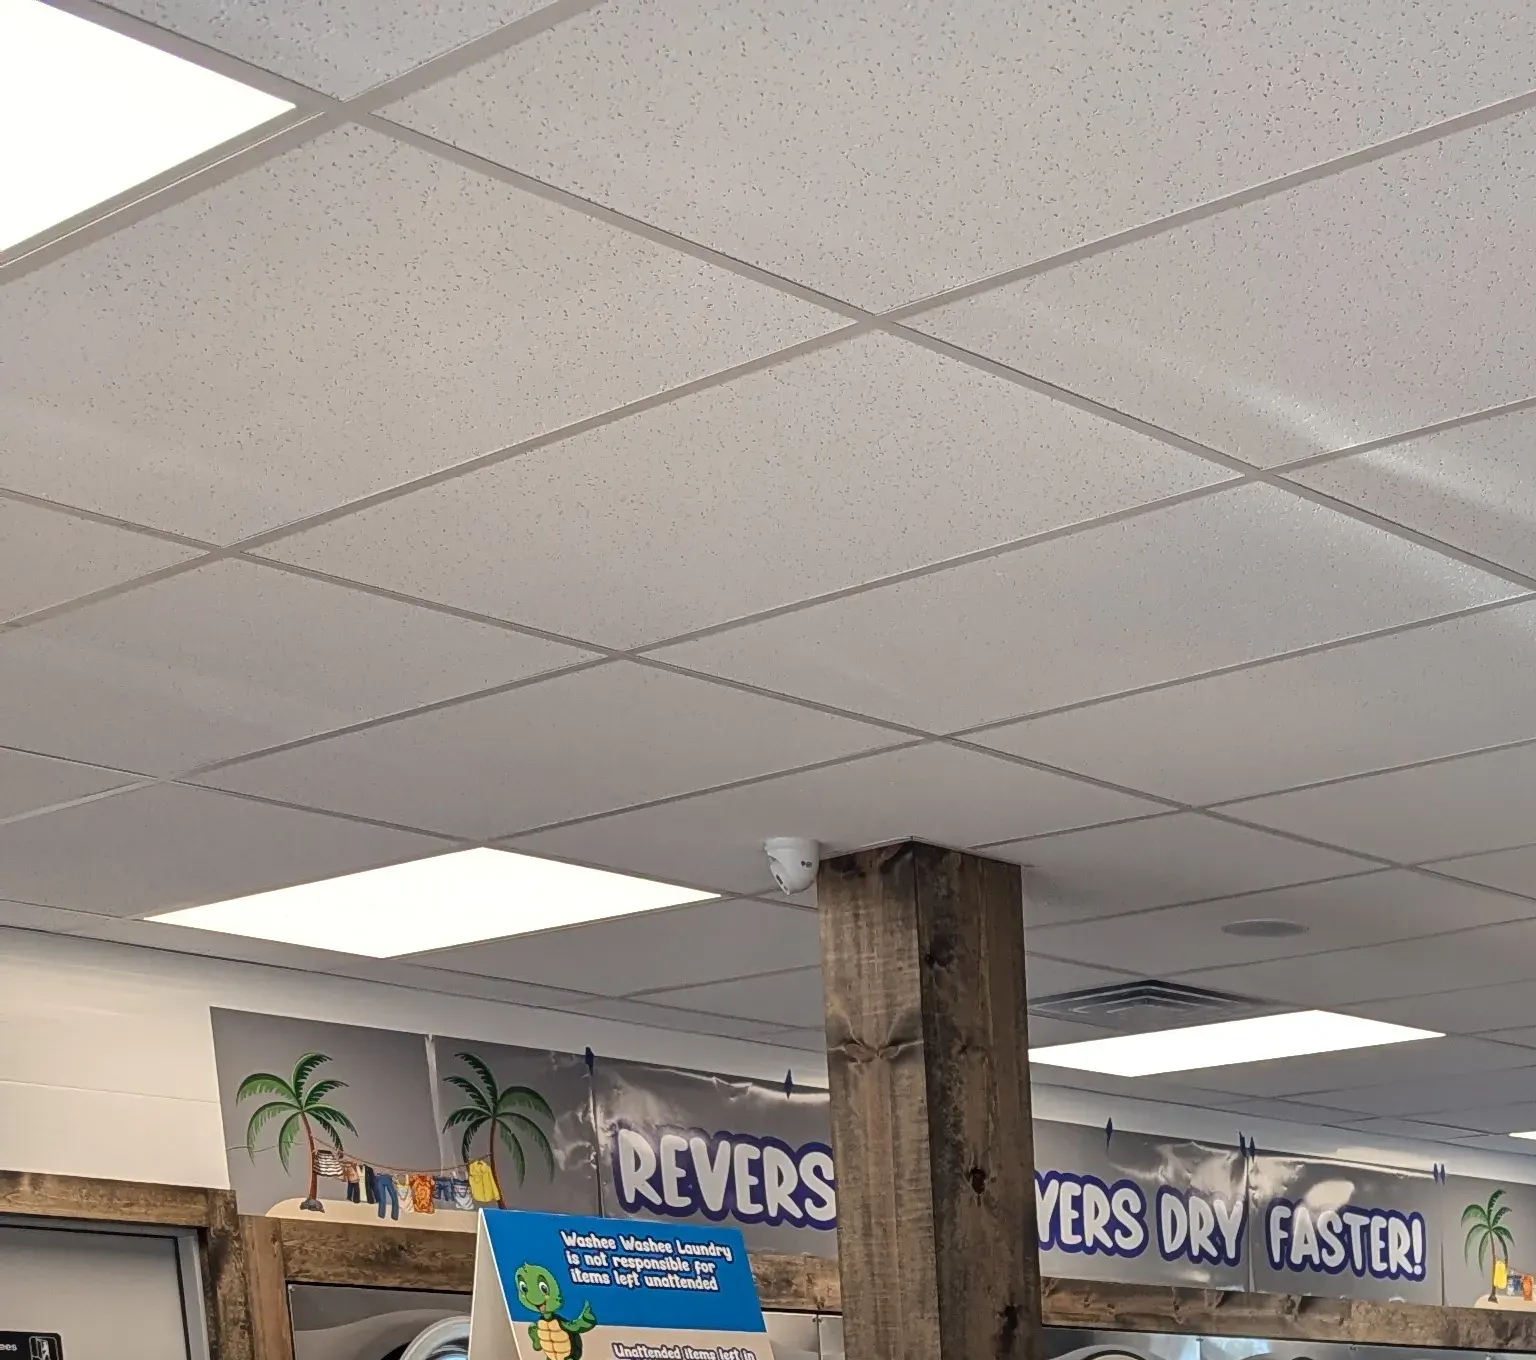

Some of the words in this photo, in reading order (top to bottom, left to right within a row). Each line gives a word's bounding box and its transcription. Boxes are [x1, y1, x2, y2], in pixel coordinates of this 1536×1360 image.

[561, 1231, 617, 1250] Washee
[619, 1236, 673, 1254] Washee
[676, 1240, 733, 1262] Laundry
[1161, 1195, 1244, 1259] DRY
[1270, 1205, 1423, 1276] FASTER!
[566, 1251, 580, 1265] is
[583, 1252, 608, 1267] not
[612, 1255, 690, 1272] responsible
[694, 1260, 716, 1275] for
[570, 1268, 611, 1285] items
[613, 1270, 641, 1288] left
[644, 1273, 719, 1291] unattended
[613, 1344, 682, 1360] Unattended
[684, 1347, 717, 1360] items
